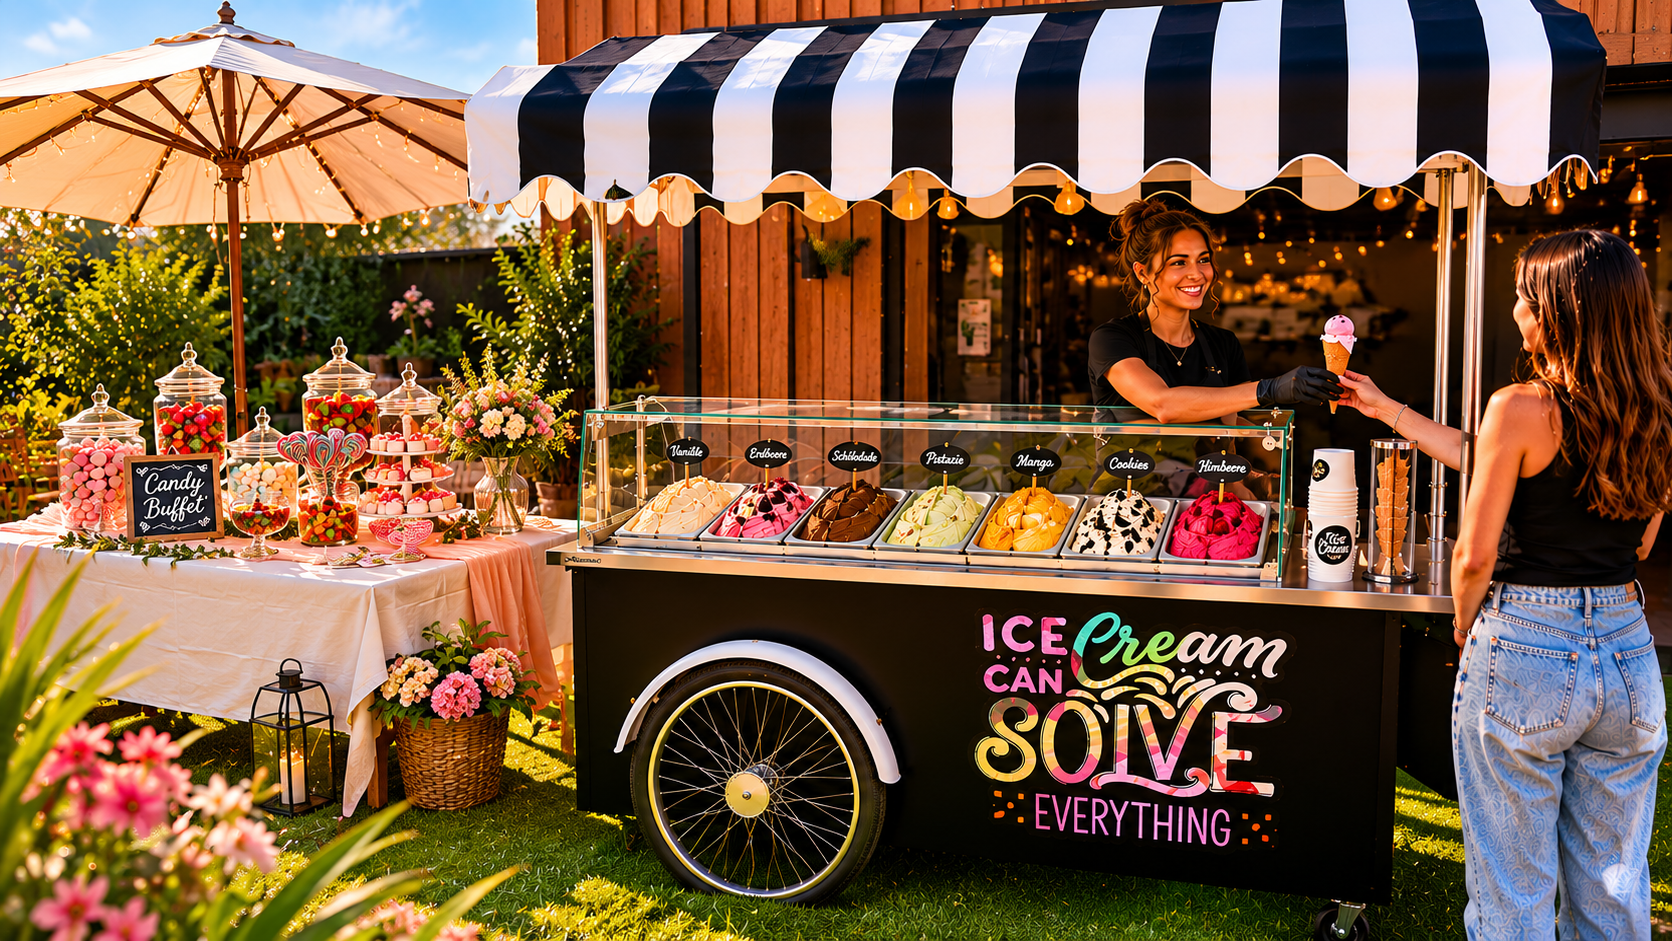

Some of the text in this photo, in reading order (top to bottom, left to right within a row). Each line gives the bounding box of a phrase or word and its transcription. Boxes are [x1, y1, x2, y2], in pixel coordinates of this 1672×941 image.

[144, 471, 205, 497] Candy
[1110, 456, 1149, 470] Cookies
[982, 611, 1288, 689] ICE Cream
[983, 664, 1063, 695] CAN
[974, 682, 1283, 798] SOLVE
[1035, 793, 1232, 847] EVERYTHING
